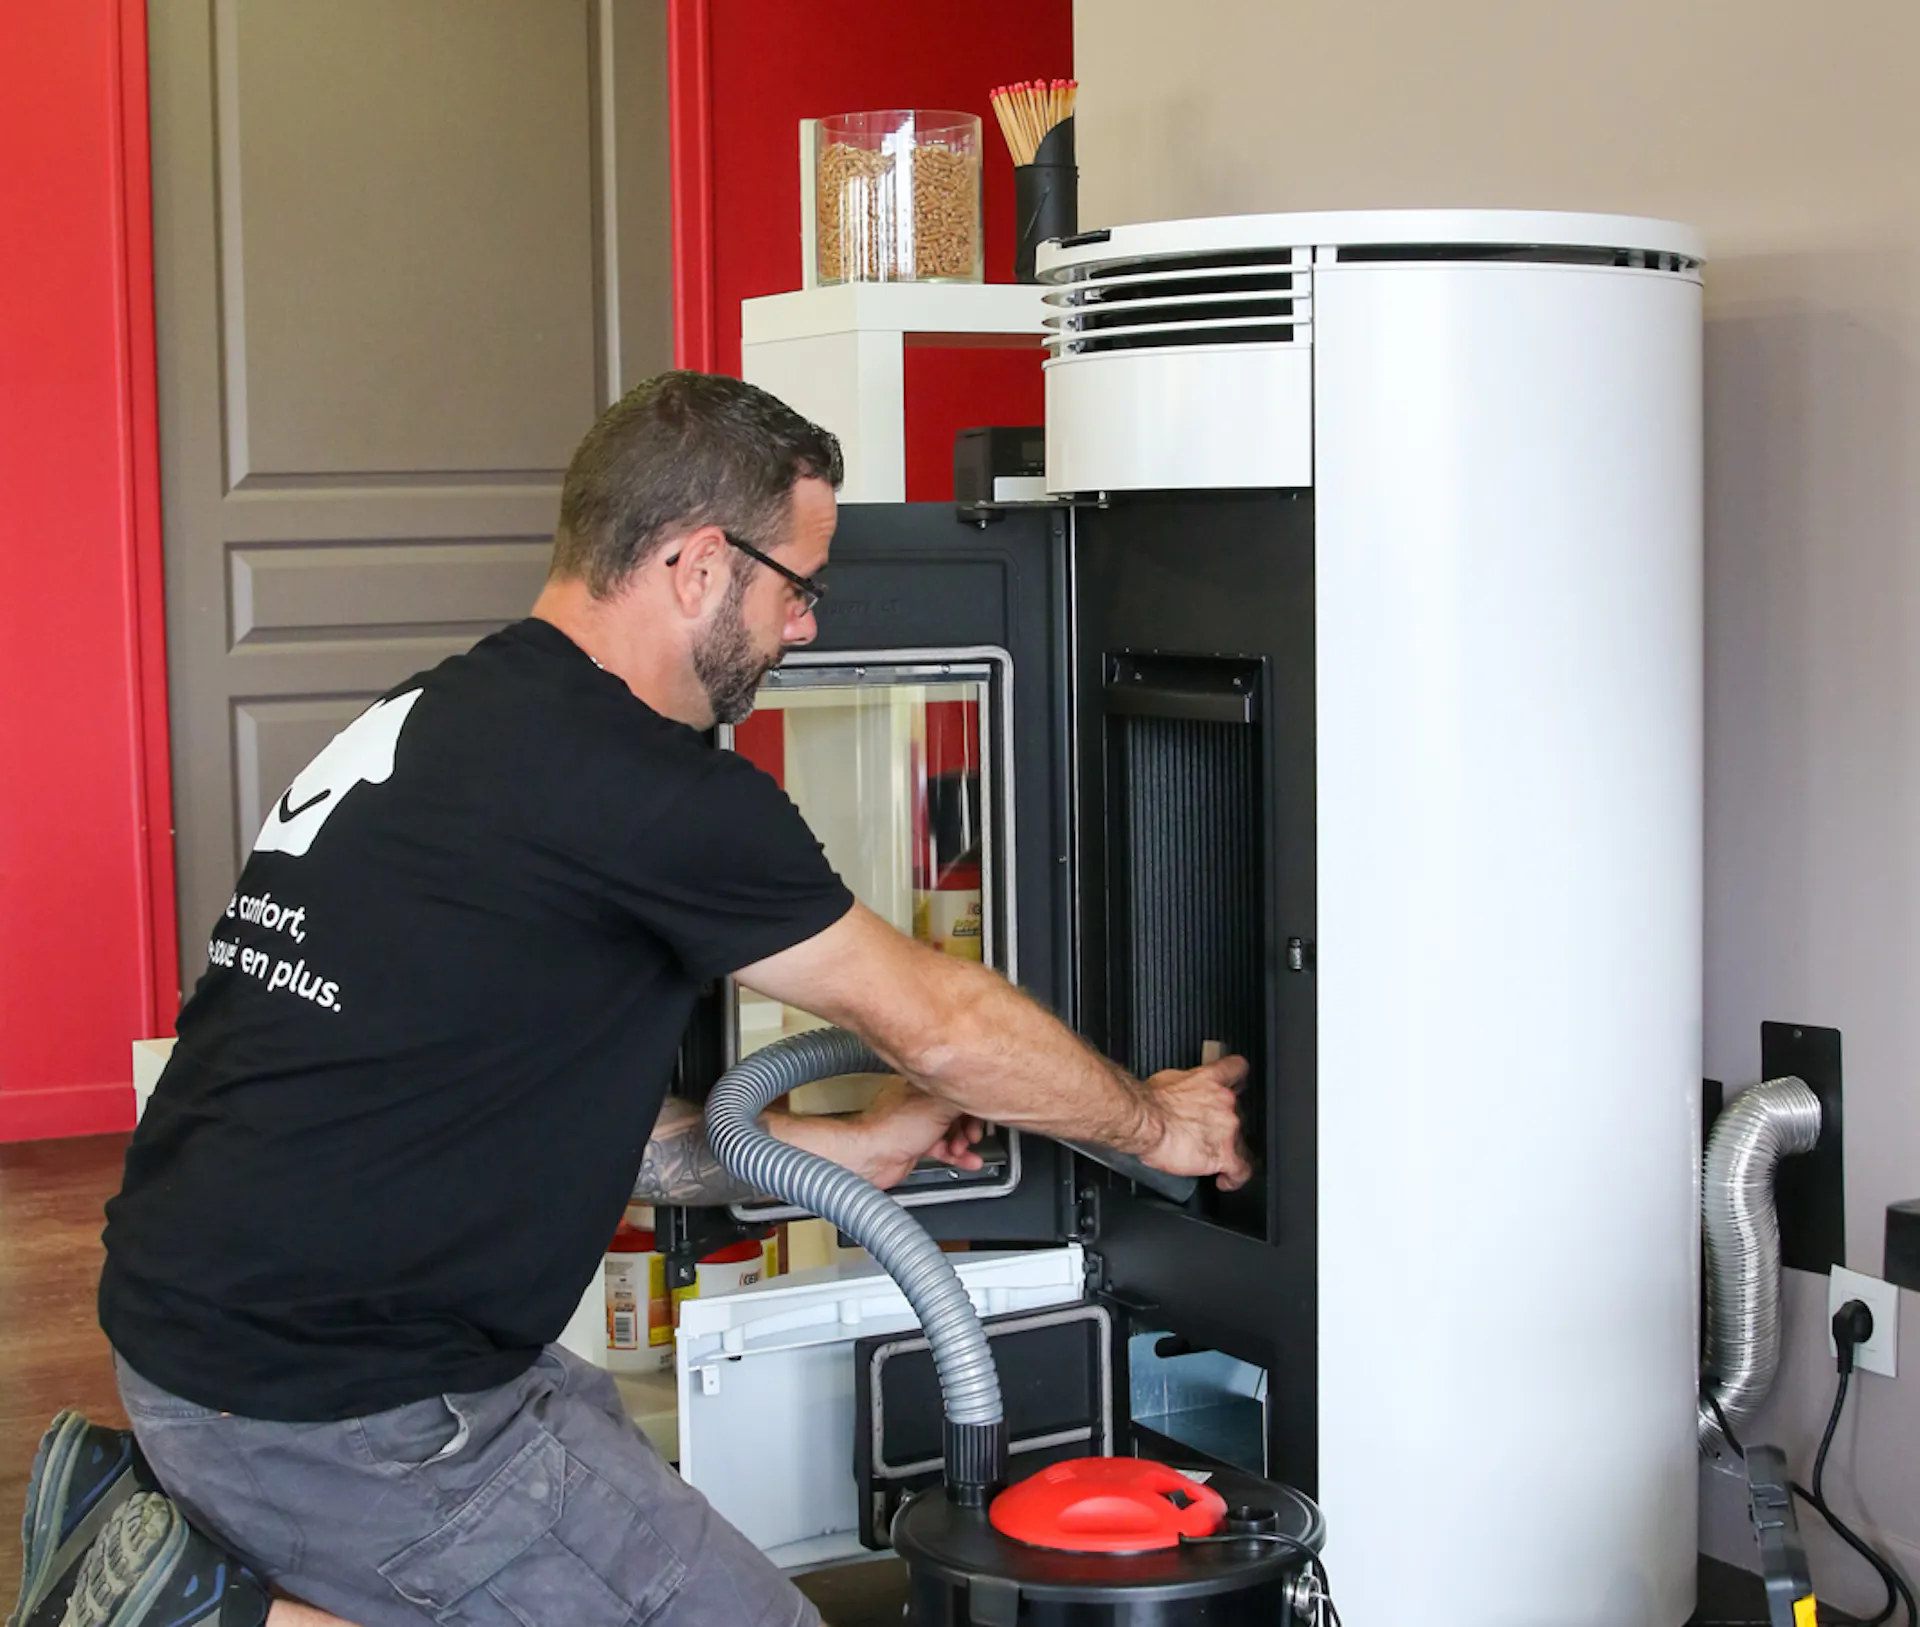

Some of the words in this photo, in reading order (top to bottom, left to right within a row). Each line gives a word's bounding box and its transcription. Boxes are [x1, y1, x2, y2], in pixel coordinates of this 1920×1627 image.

[239, 892, 307, 944] confort,
[240, 947, 268, 979] en
[267, 959, 342, 1013] plus.
